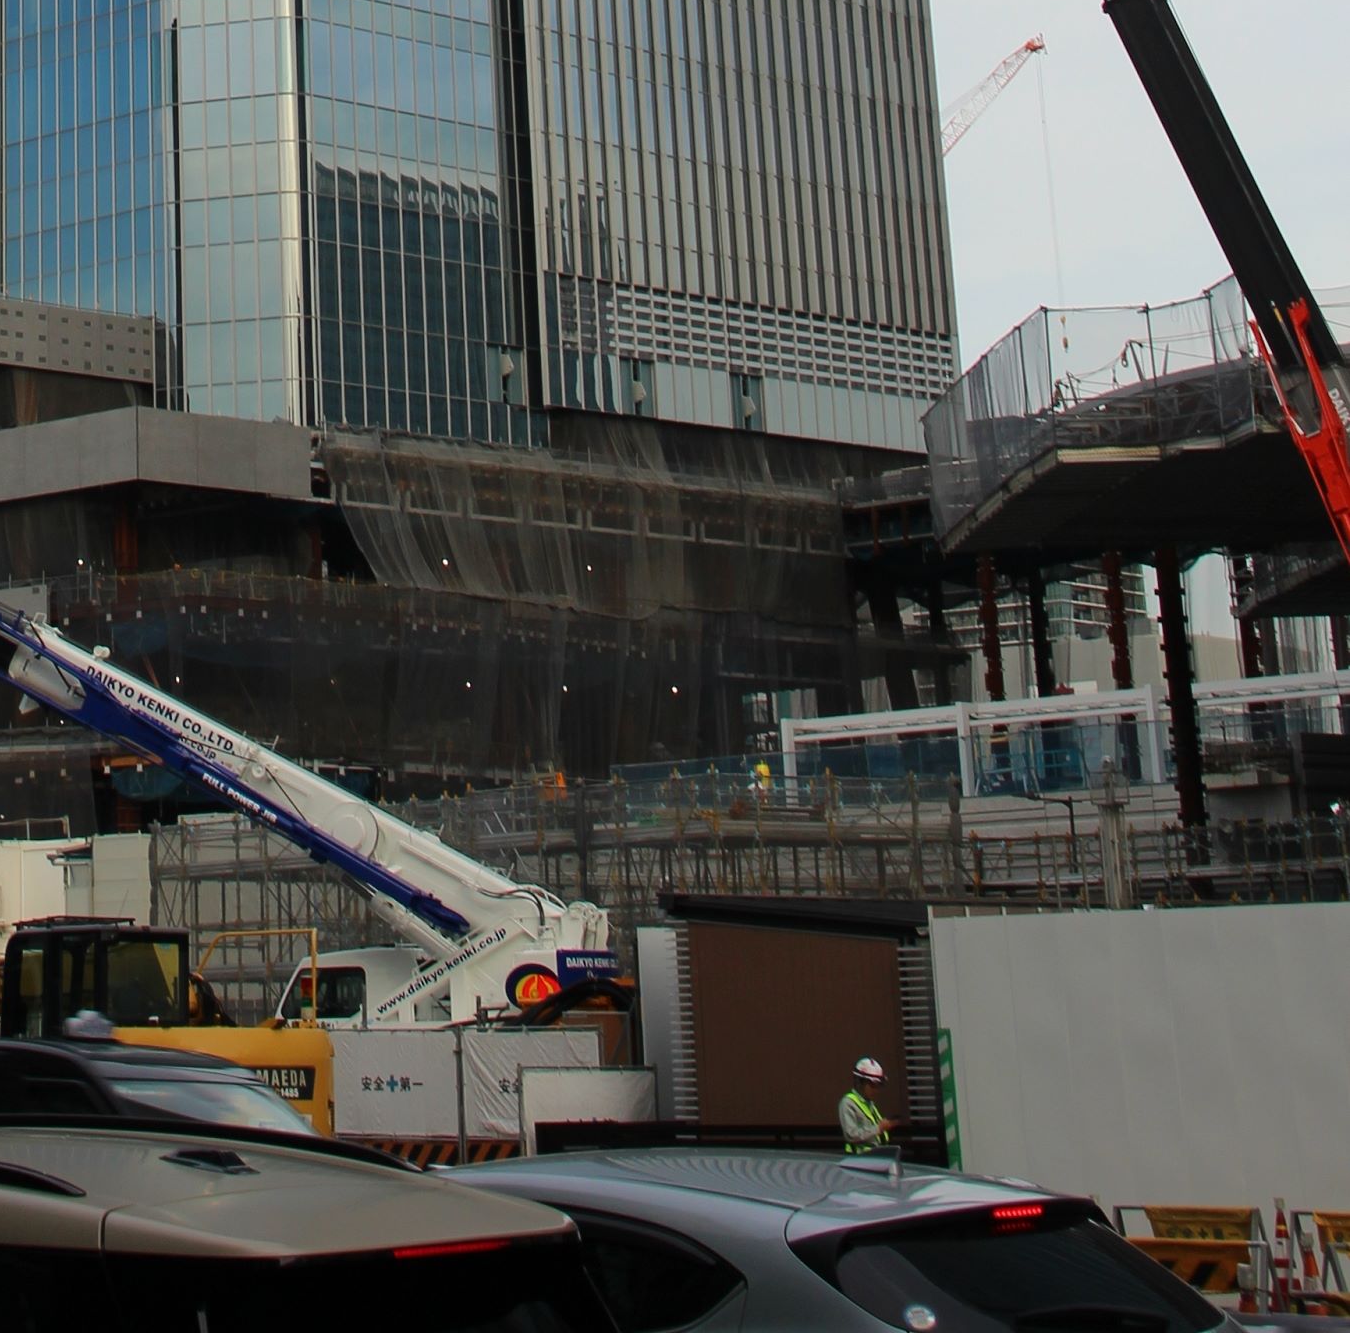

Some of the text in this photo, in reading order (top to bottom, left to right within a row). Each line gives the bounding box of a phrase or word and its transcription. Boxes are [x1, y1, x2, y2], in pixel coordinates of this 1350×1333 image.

[1328, 388, 1350, 432] DAIK
[86, 665, 135, 699] DAIKYO
[137, 692, 181, 723] KENKI
[202, 772, 225, 793] FULL
[226, 786, 261, 814] POWER
[377, 927, 507, 1014] www.daikyo-kenki.co.jp
[565, 956, 594, 968] DAIKYO
[256, 1069, 307, 1087] MAEDA
